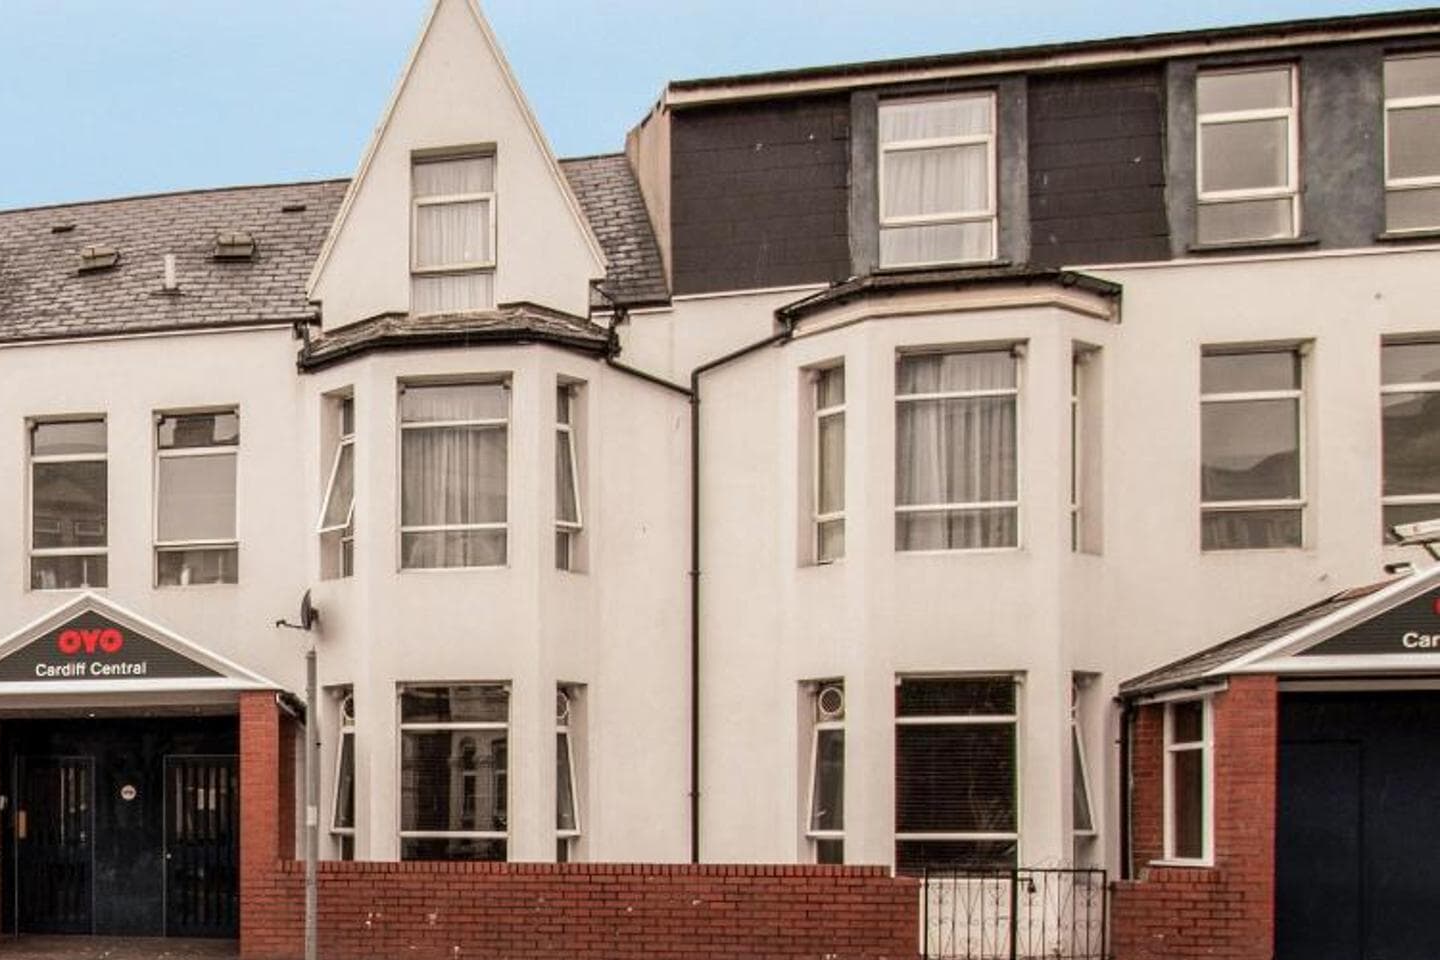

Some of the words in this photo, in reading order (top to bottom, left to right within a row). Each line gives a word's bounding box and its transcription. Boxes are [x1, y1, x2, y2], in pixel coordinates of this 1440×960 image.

[58, 629, 123, 654] OYO
[35, 662, 86, 676] Cardiff
[90, 661, 147, 675] Central
